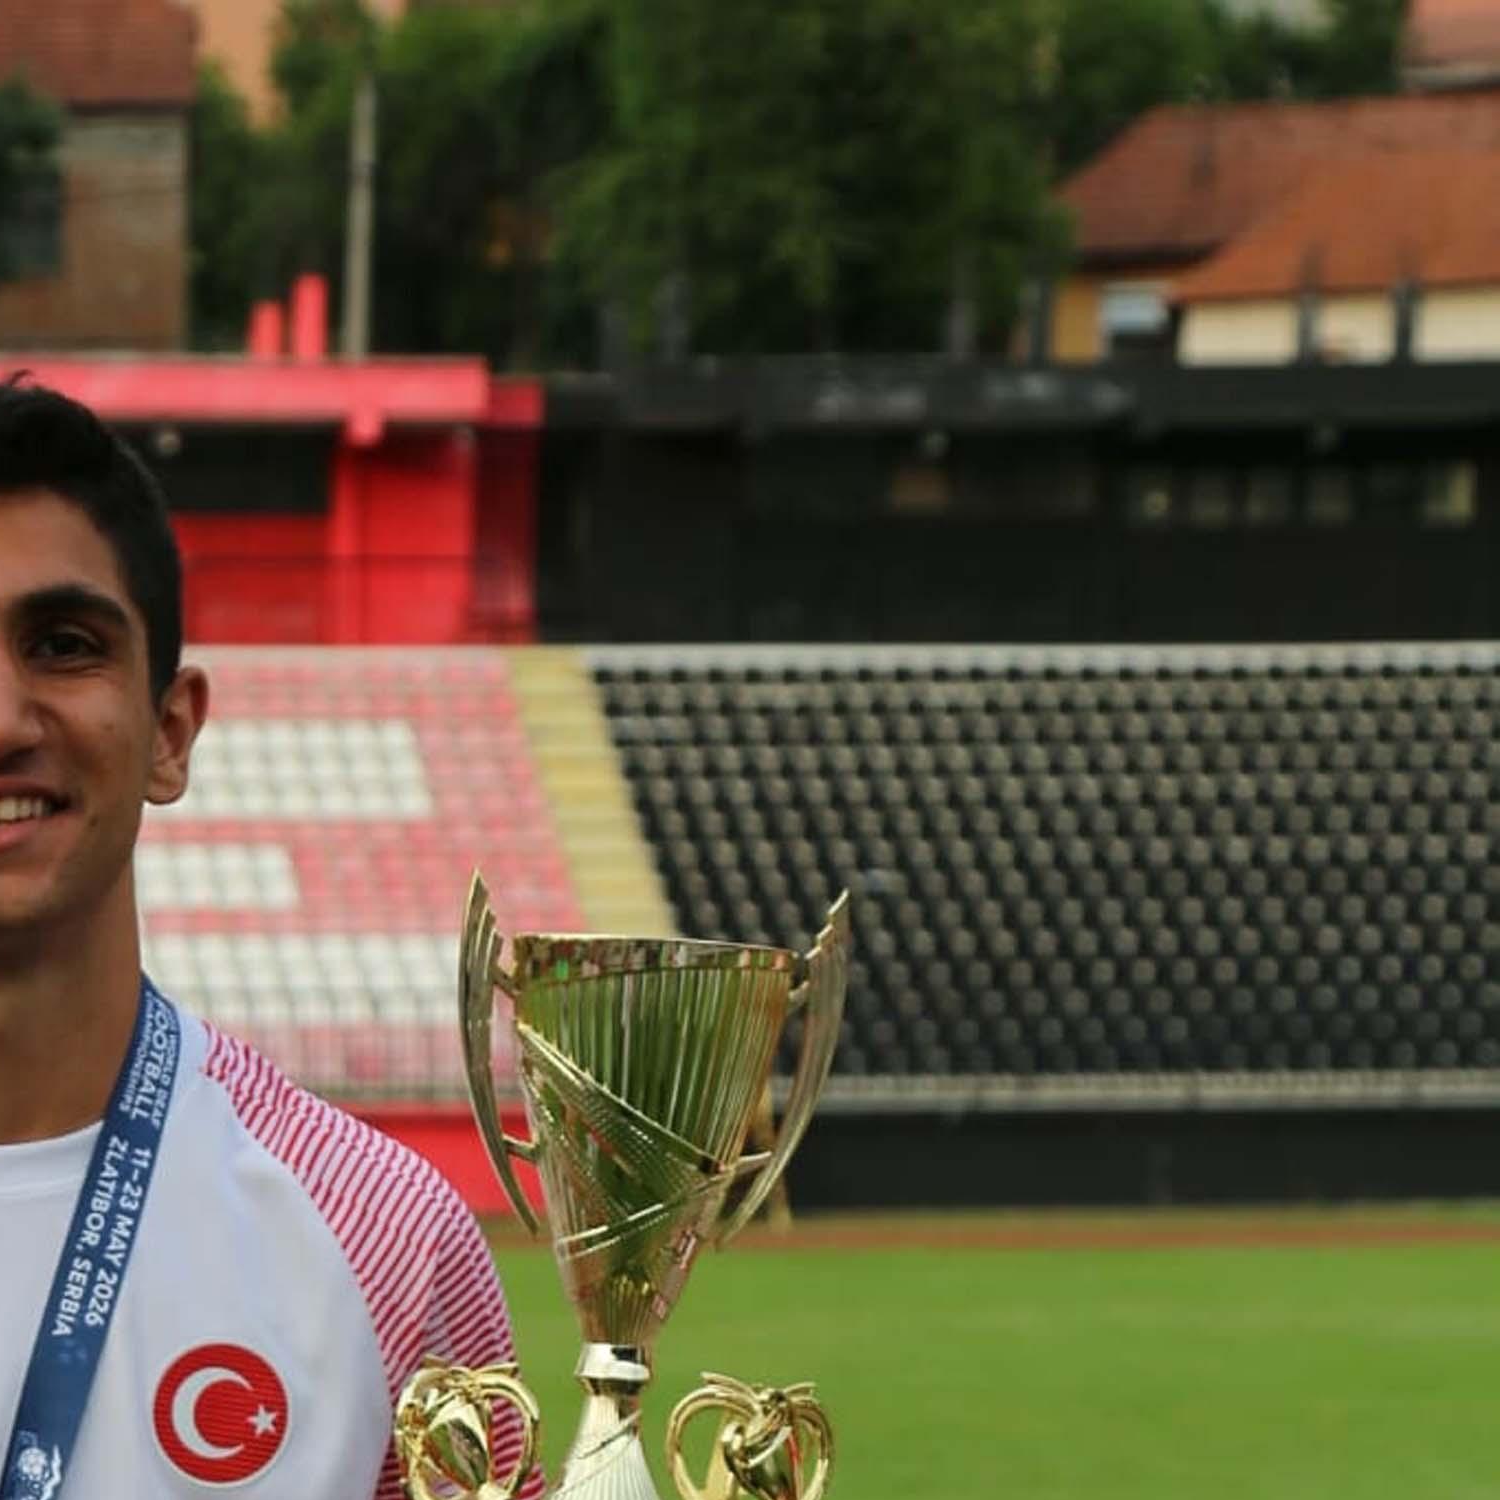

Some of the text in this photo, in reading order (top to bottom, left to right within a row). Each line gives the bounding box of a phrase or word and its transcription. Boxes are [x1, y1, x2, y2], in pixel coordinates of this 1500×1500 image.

[51, 1136, 129, 1336] ZLATIBOR, SERBIA
[103, 1213, 135, 1266] MAY
[85, 1268, 118, 1326] 2026
